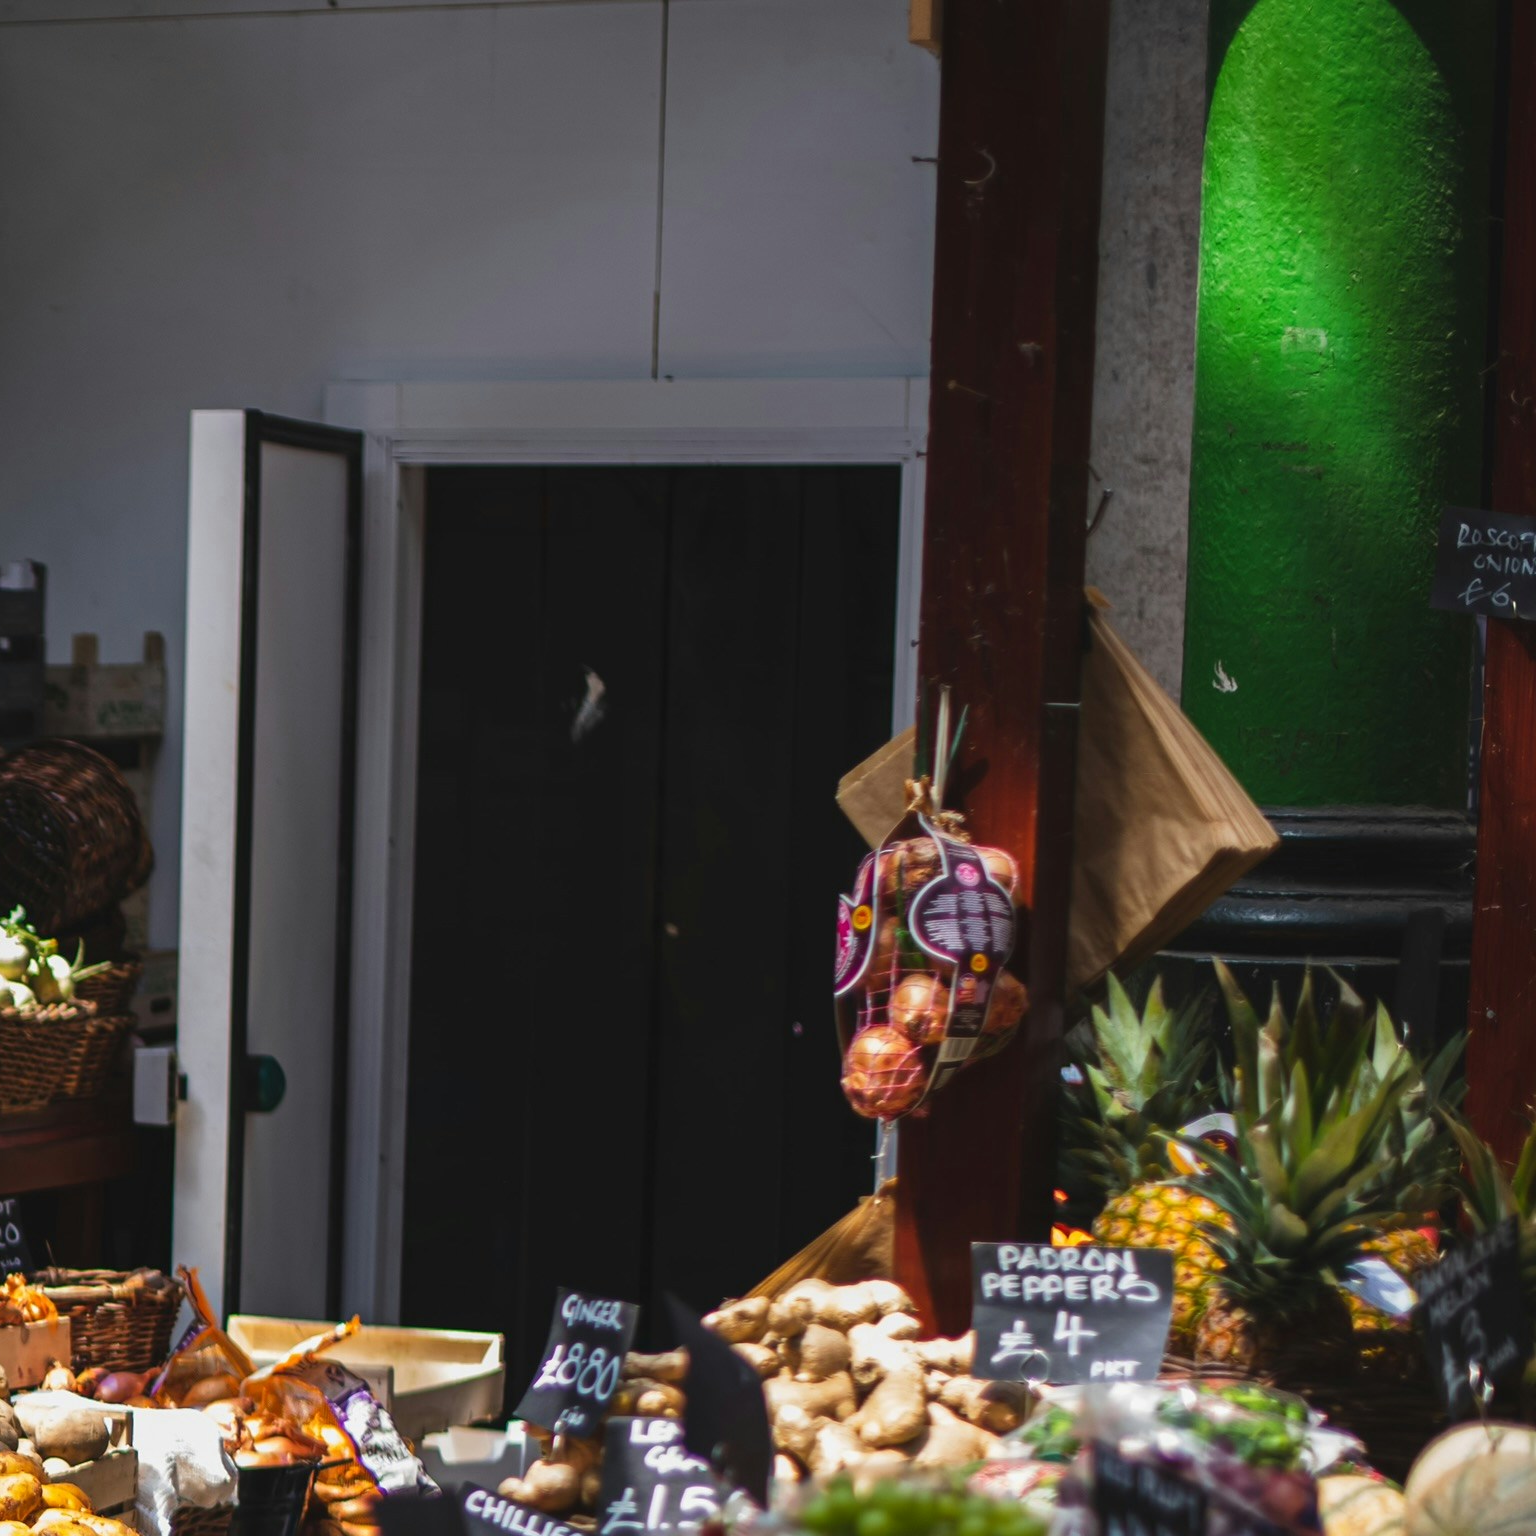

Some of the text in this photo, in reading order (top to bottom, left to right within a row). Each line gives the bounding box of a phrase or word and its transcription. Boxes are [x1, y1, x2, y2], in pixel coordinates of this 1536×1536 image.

[997, 1245, 1137, 1273] PADRON
[981, 1272, 1160, 1302] PEPPERS
[561, 1293, 622, 1331] GINGER
[532, 1342, 621, 1401] £8.80
